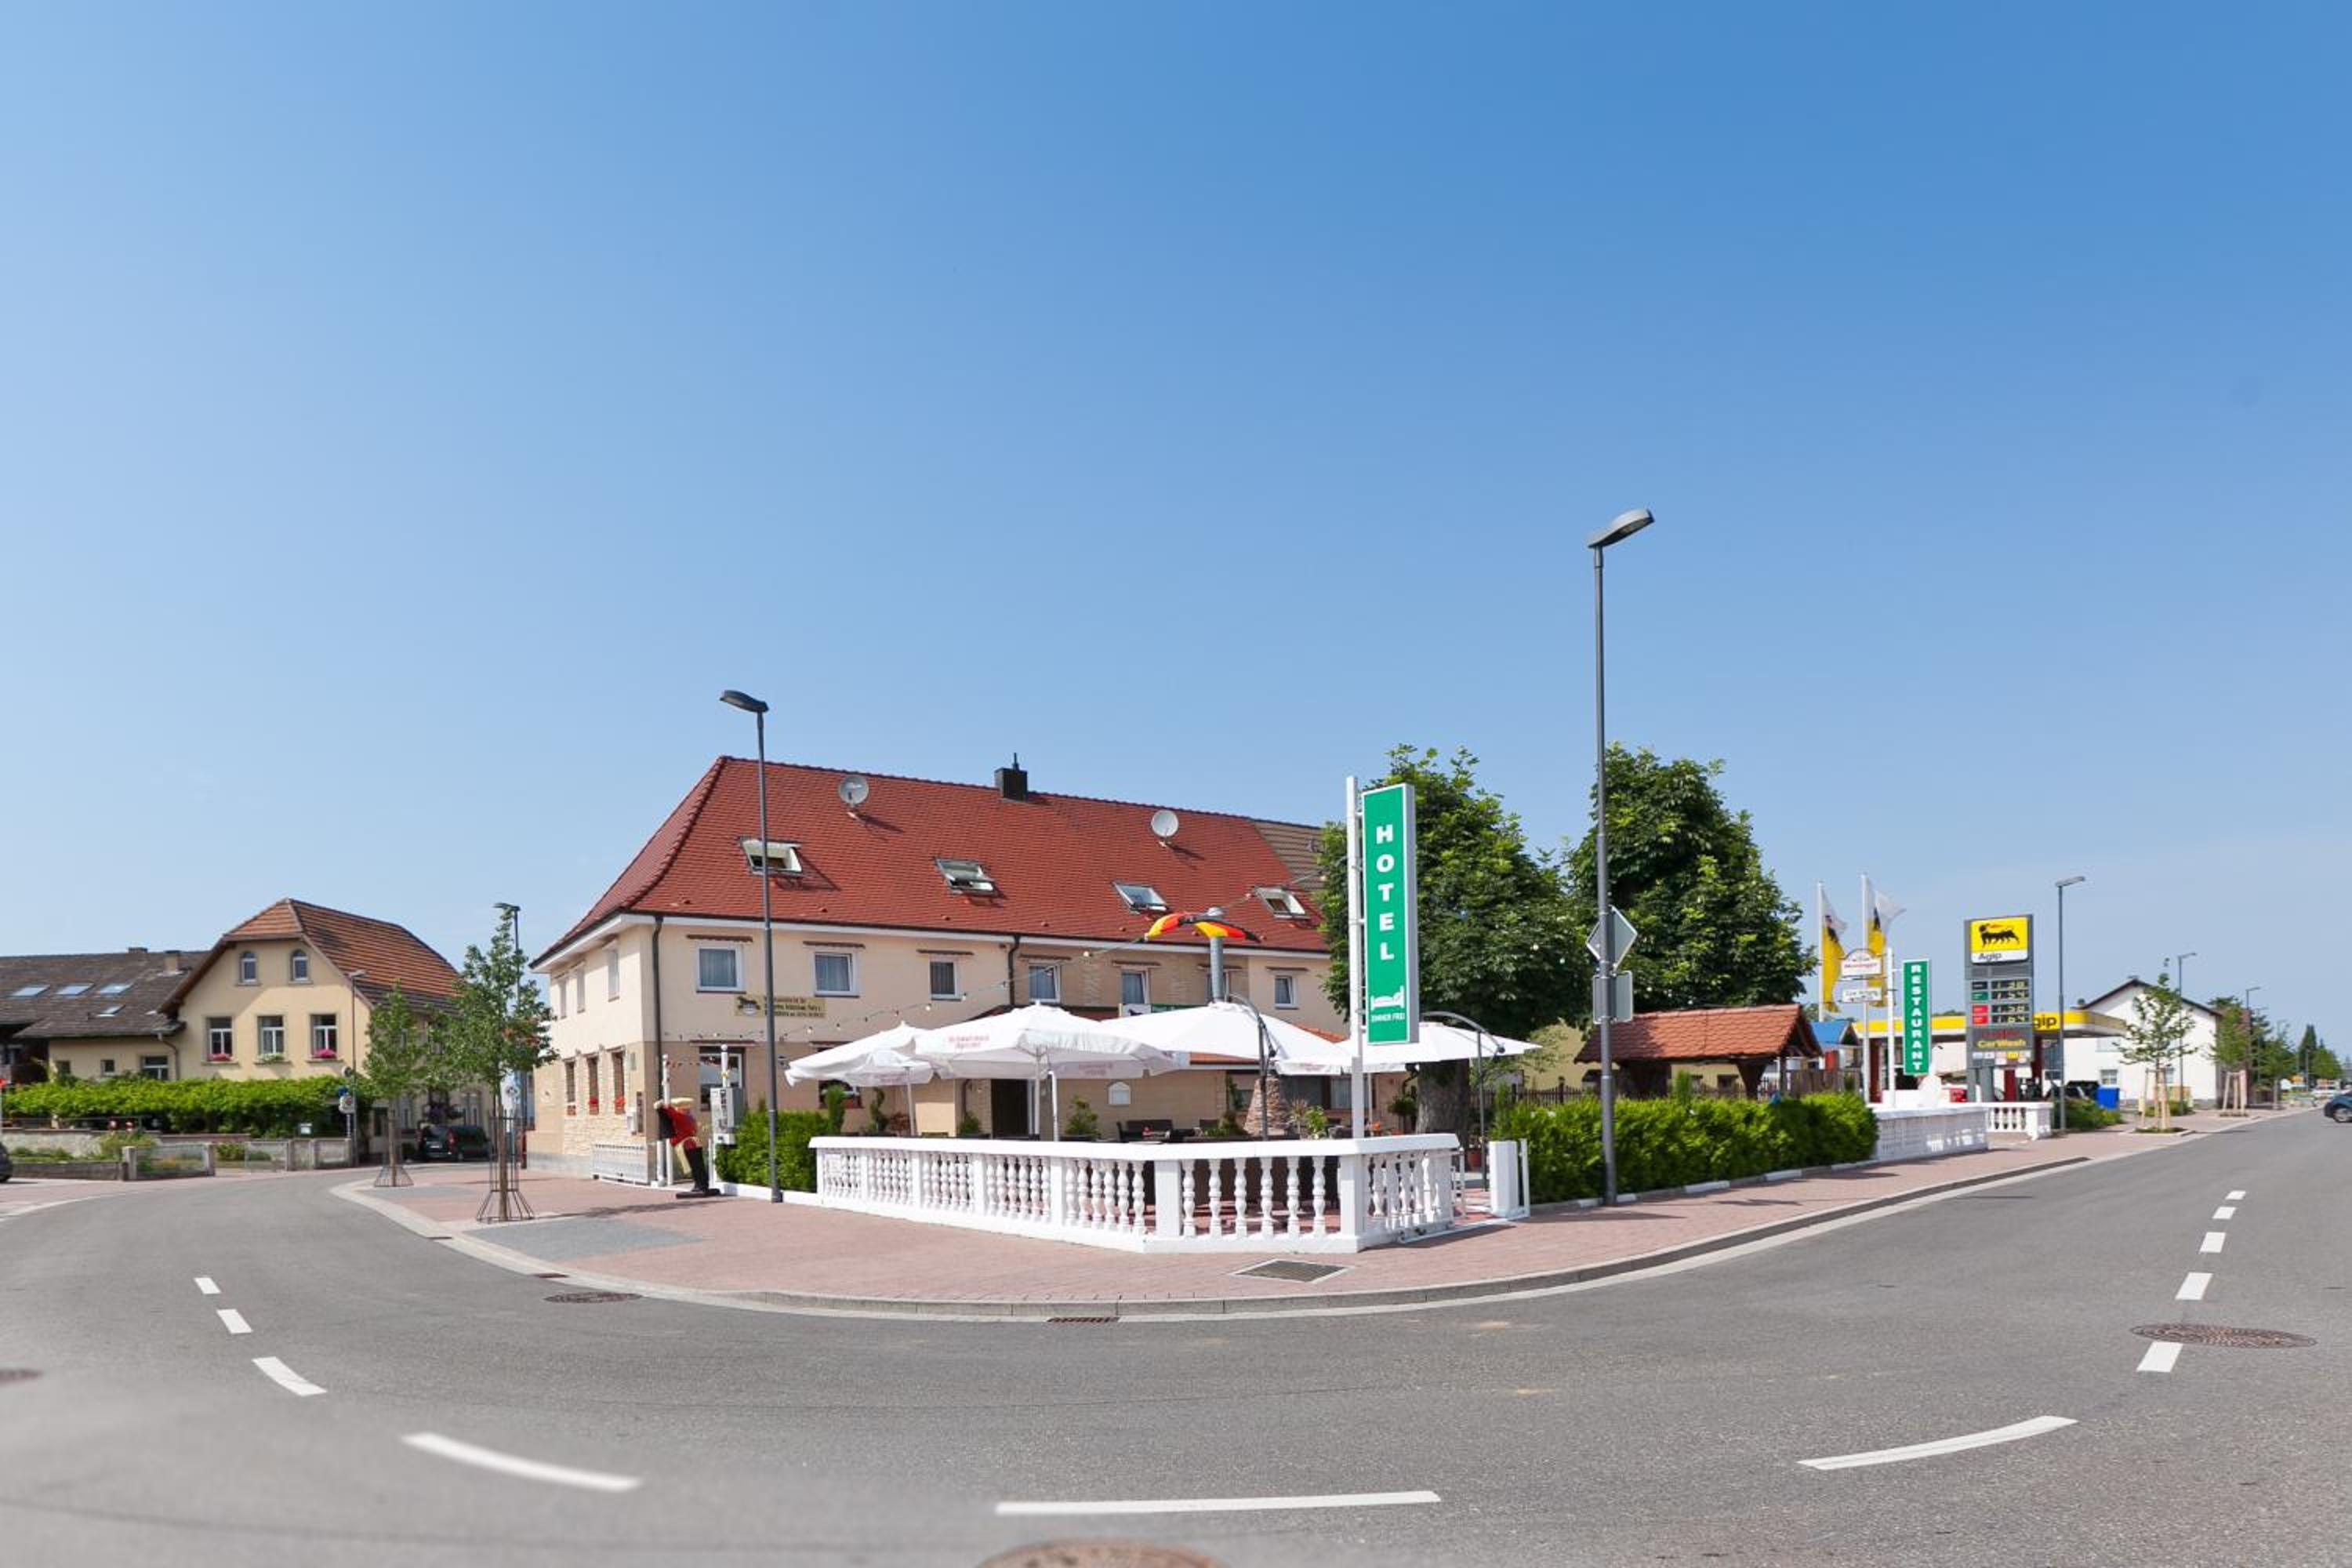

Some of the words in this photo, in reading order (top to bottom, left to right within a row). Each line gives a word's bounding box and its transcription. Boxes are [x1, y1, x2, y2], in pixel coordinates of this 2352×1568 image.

[1376, 824, 1395, 960] HOTEL
[1978, 953, 2002, 962] Agip
[1911, 965, 1922, 1070] RESTAURANT
[2032, 1014, 2057, 1029] gip
